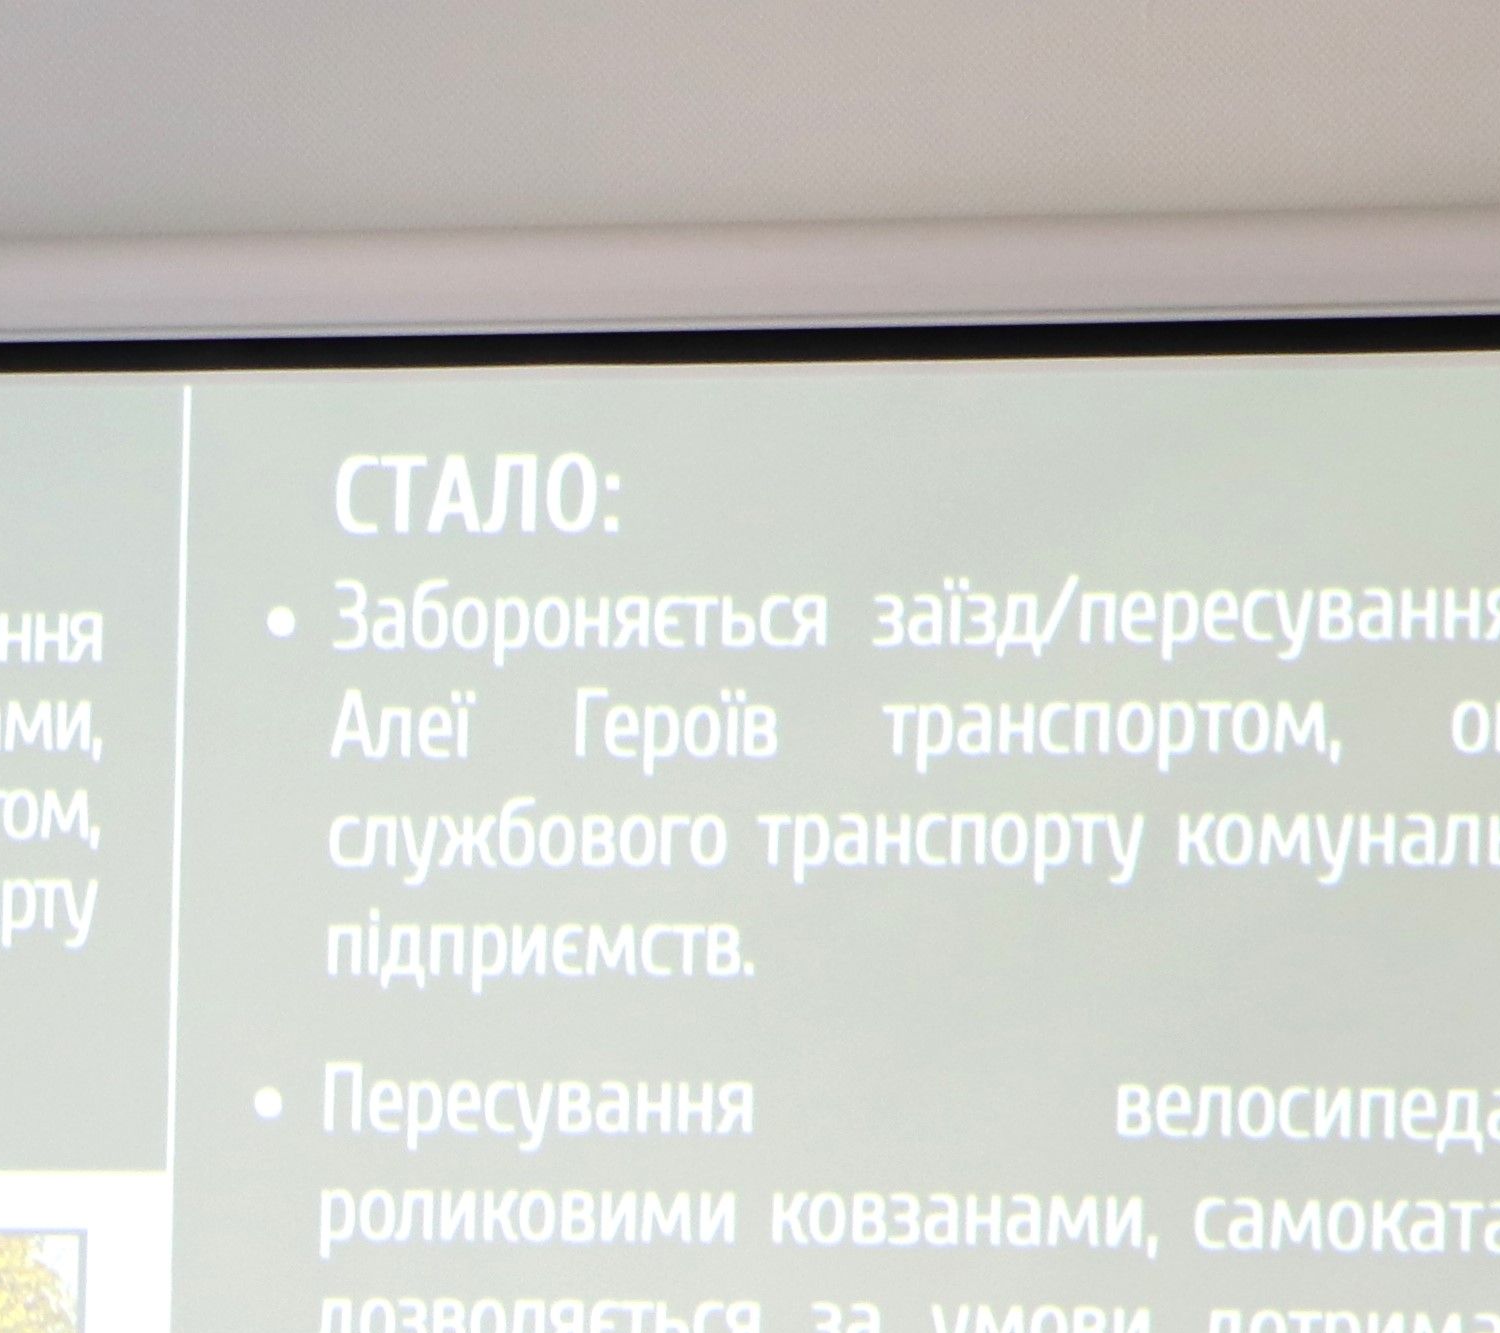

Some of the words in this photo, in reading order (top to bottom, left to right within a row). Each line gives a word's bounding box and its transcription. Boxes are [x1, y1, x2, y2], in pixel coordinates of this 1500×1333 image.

[333, 451, 623, 536] СТАЛО:
[330, 578, 829, 669] Забороняється
[327, 687, 478, 761] Алеї
[572, 686, 780, 778] Героїв
[879, 700, 1343, 777] транспортом,
[326, 795, 730, 889] службового
[754, 811, 1146, 887] транспорту
[324, 906, 756, 996] підприємств.
[320, 1061, 756, 1154] Пересування
[316, 1187, 738, 1261] роликовими
[768, 1190, 1160, 1261] ковзанами,
